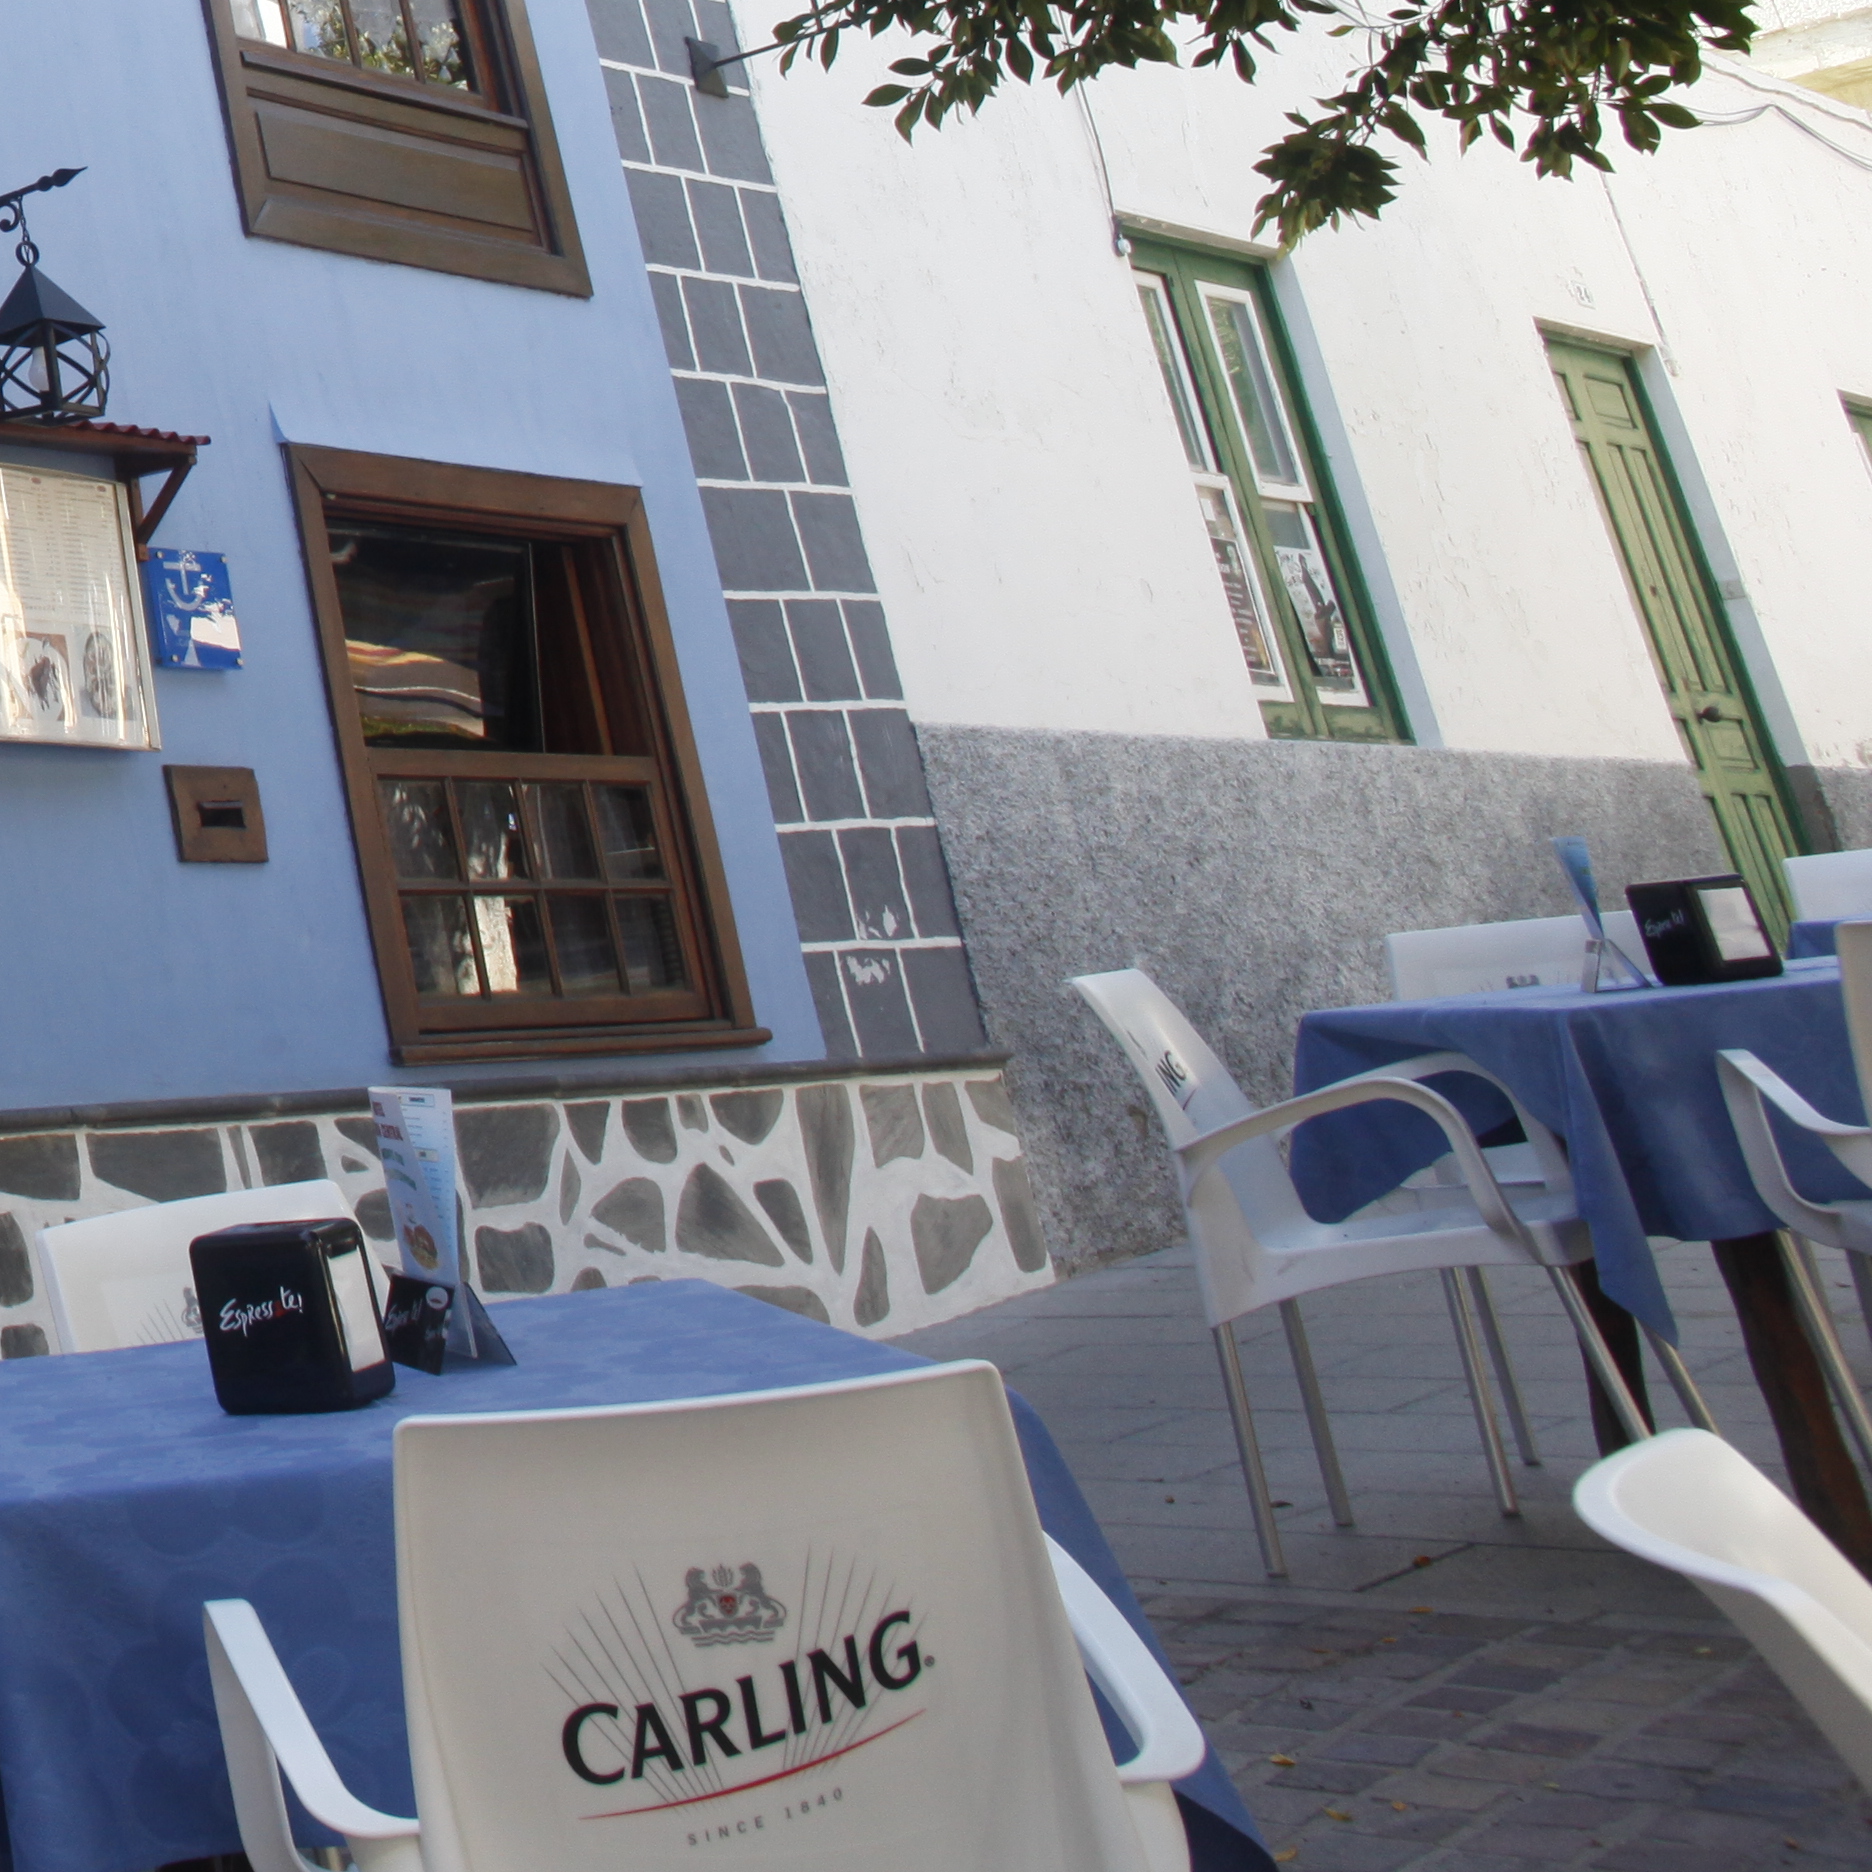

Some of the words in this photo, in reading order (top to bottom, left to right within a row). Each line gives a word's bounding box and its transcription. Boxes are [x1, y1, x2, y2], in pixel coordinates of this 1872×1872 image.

[562, 1609, 922, 1785] CARLING
[687, 1815, 765, 1846] SINCE
[784, 1787, 844, 1821] 1840
